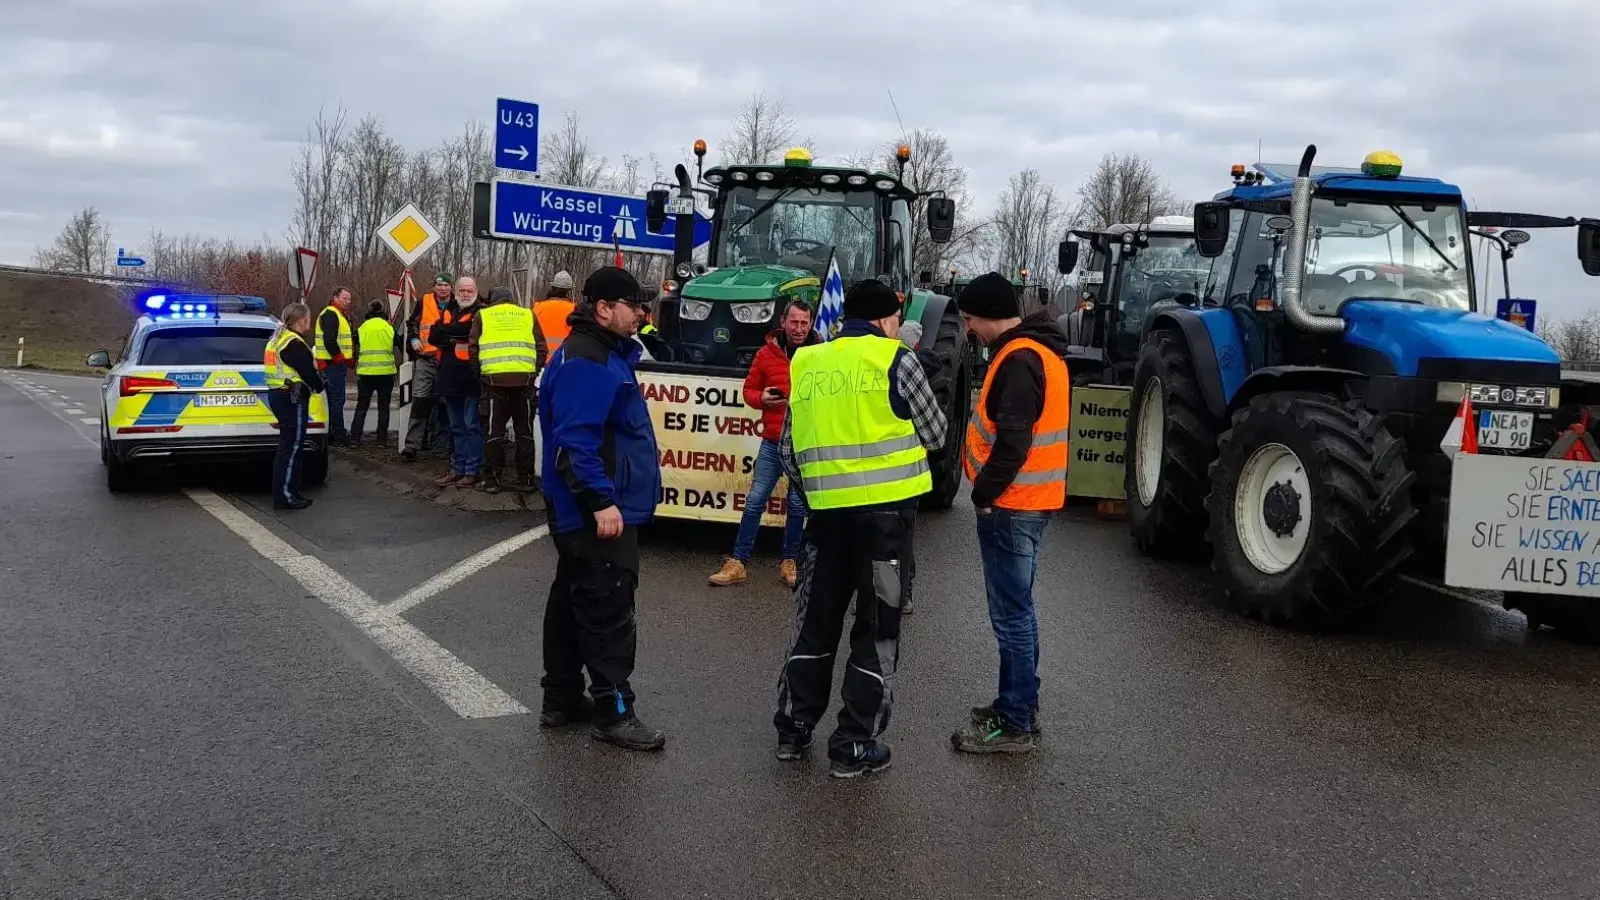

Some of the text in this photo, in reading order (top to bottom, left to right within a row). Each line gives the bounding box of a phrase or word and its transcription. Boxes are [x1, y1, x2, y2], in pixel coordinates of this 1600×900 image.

[501, 109, 534, 128] U 43
[541, 190, 603, 214] Kassel
[512, 211, 603, 242] Würzburg
[797, 369, 883, 401] ORDNER
[200, 396, 208, 405] N
[215, 396, 228, 405] PP
[664, 411, 686, 431] ES
[690, 413, 709, 433] JE
[1491, 415, 1518, 430] NEA
[1481, 432, 1528, 446] YJ 90
[1077, 448, 1100, 462] für
[1525, 466, 1557, 491] SIE
[684, 488, 727, 509] DAS
[1506, 493, 1542, 518] SIE
[1471, 522, 1508, 548] SIE
[1519, 527, 1589, 552] WISSEN
[1501, 557, 1567, 586] ALLES
